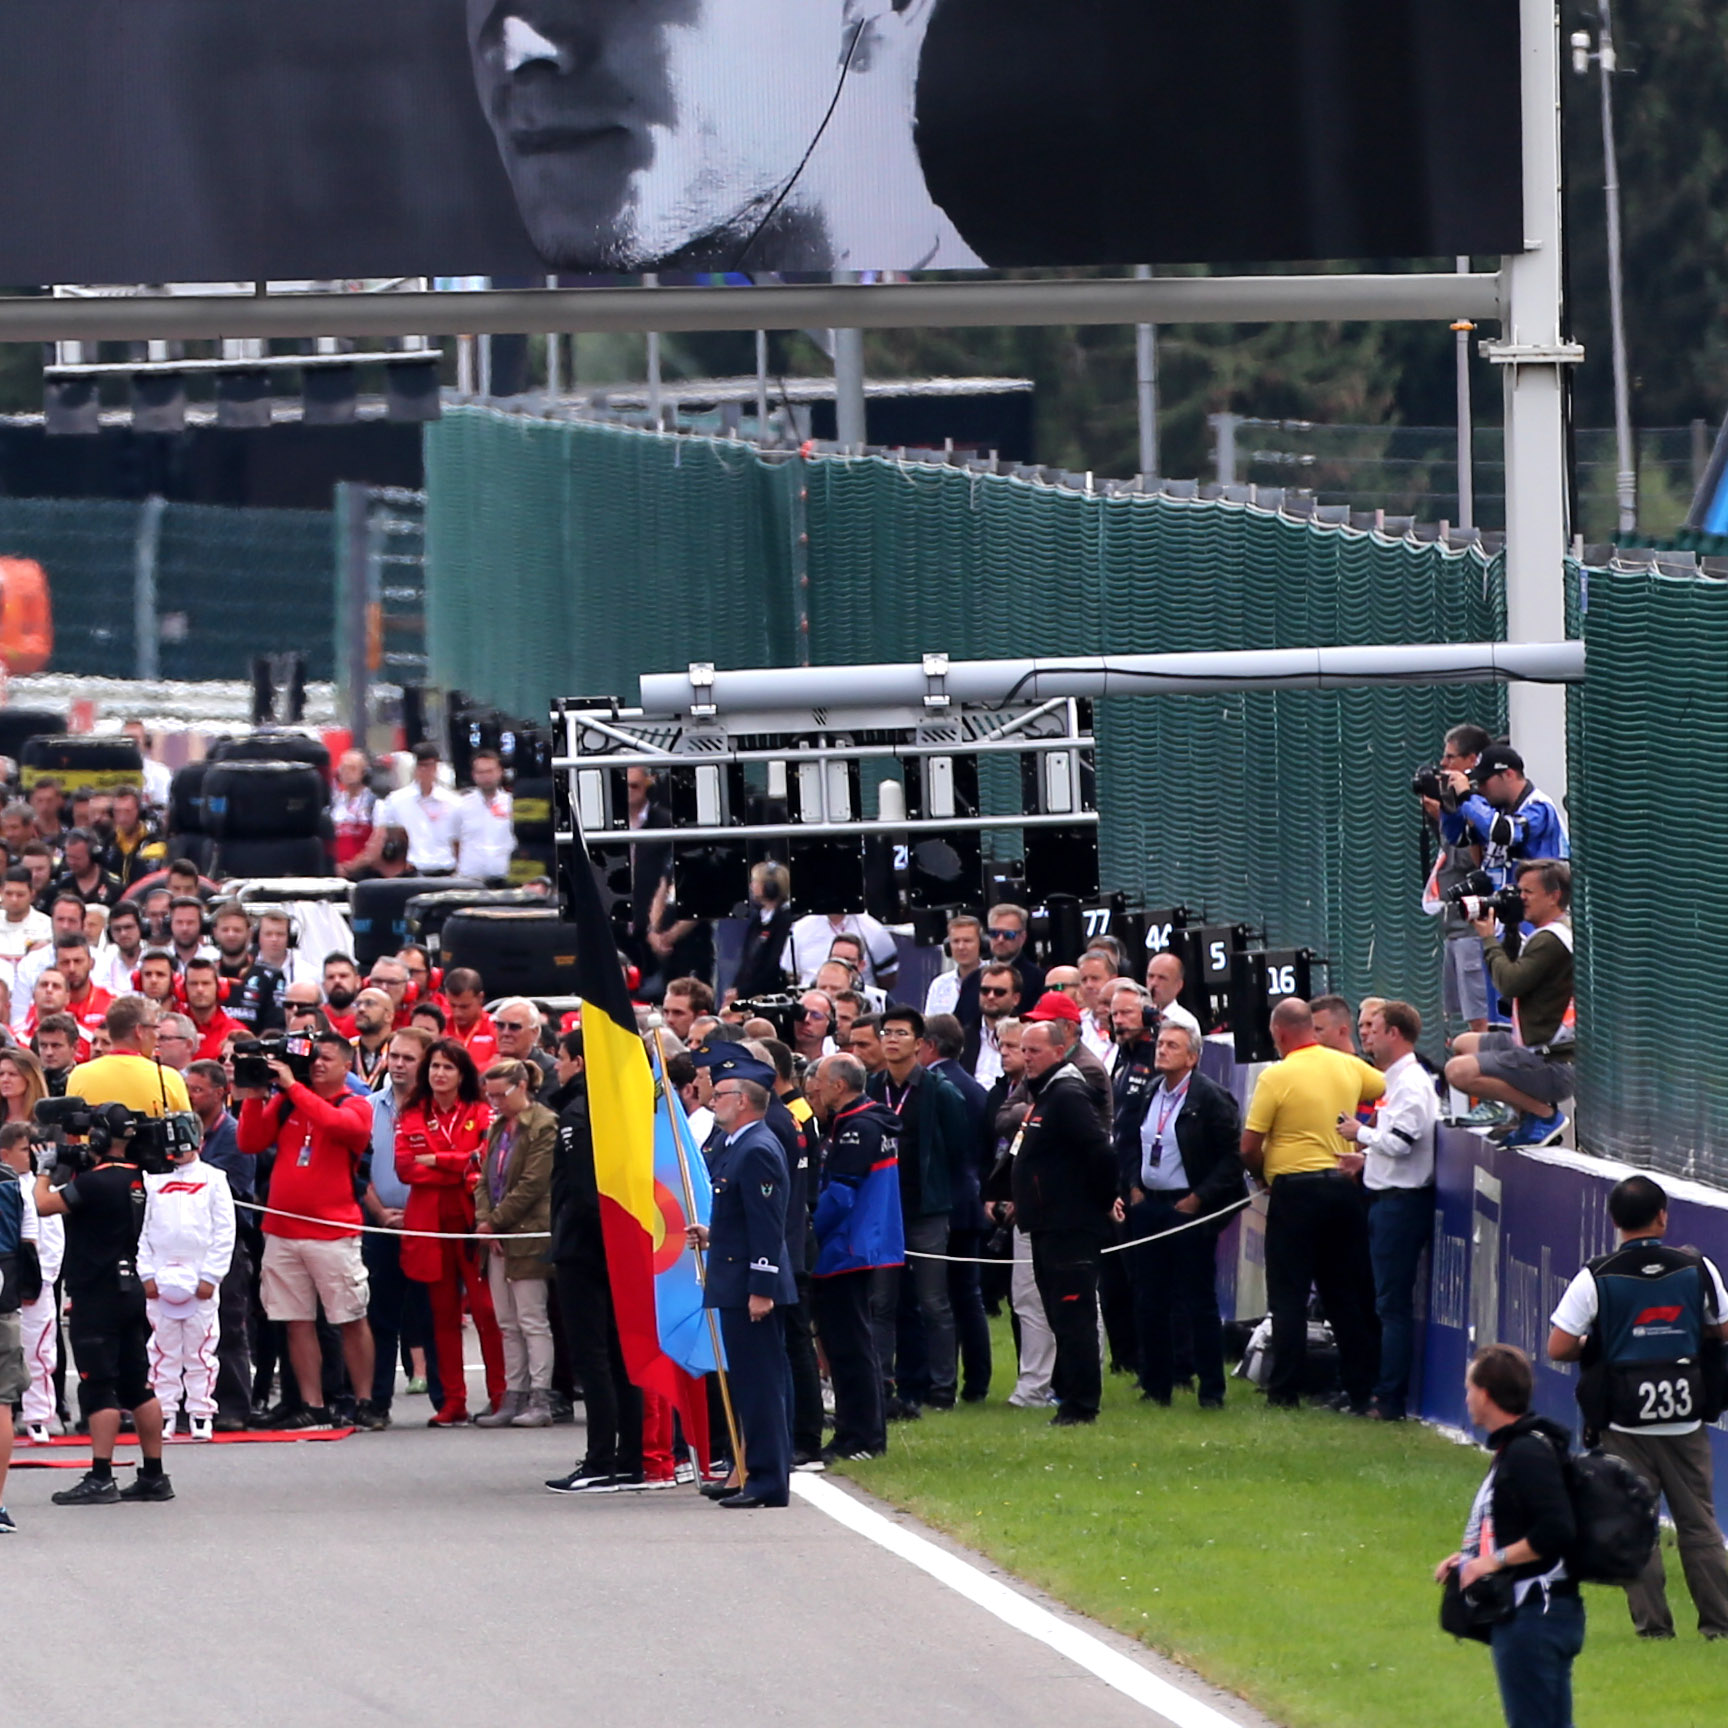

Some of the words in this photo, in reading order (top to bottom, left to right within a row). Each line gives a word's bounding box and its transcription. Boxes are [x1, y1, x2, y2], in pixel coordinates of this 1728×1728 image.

[1082, 909, 1111, 938] 77
[1209, 941, 1228, 971] 5
[1266, 964, 1298, 996] 16
[1638, 1377, 1693, 1420] 233
